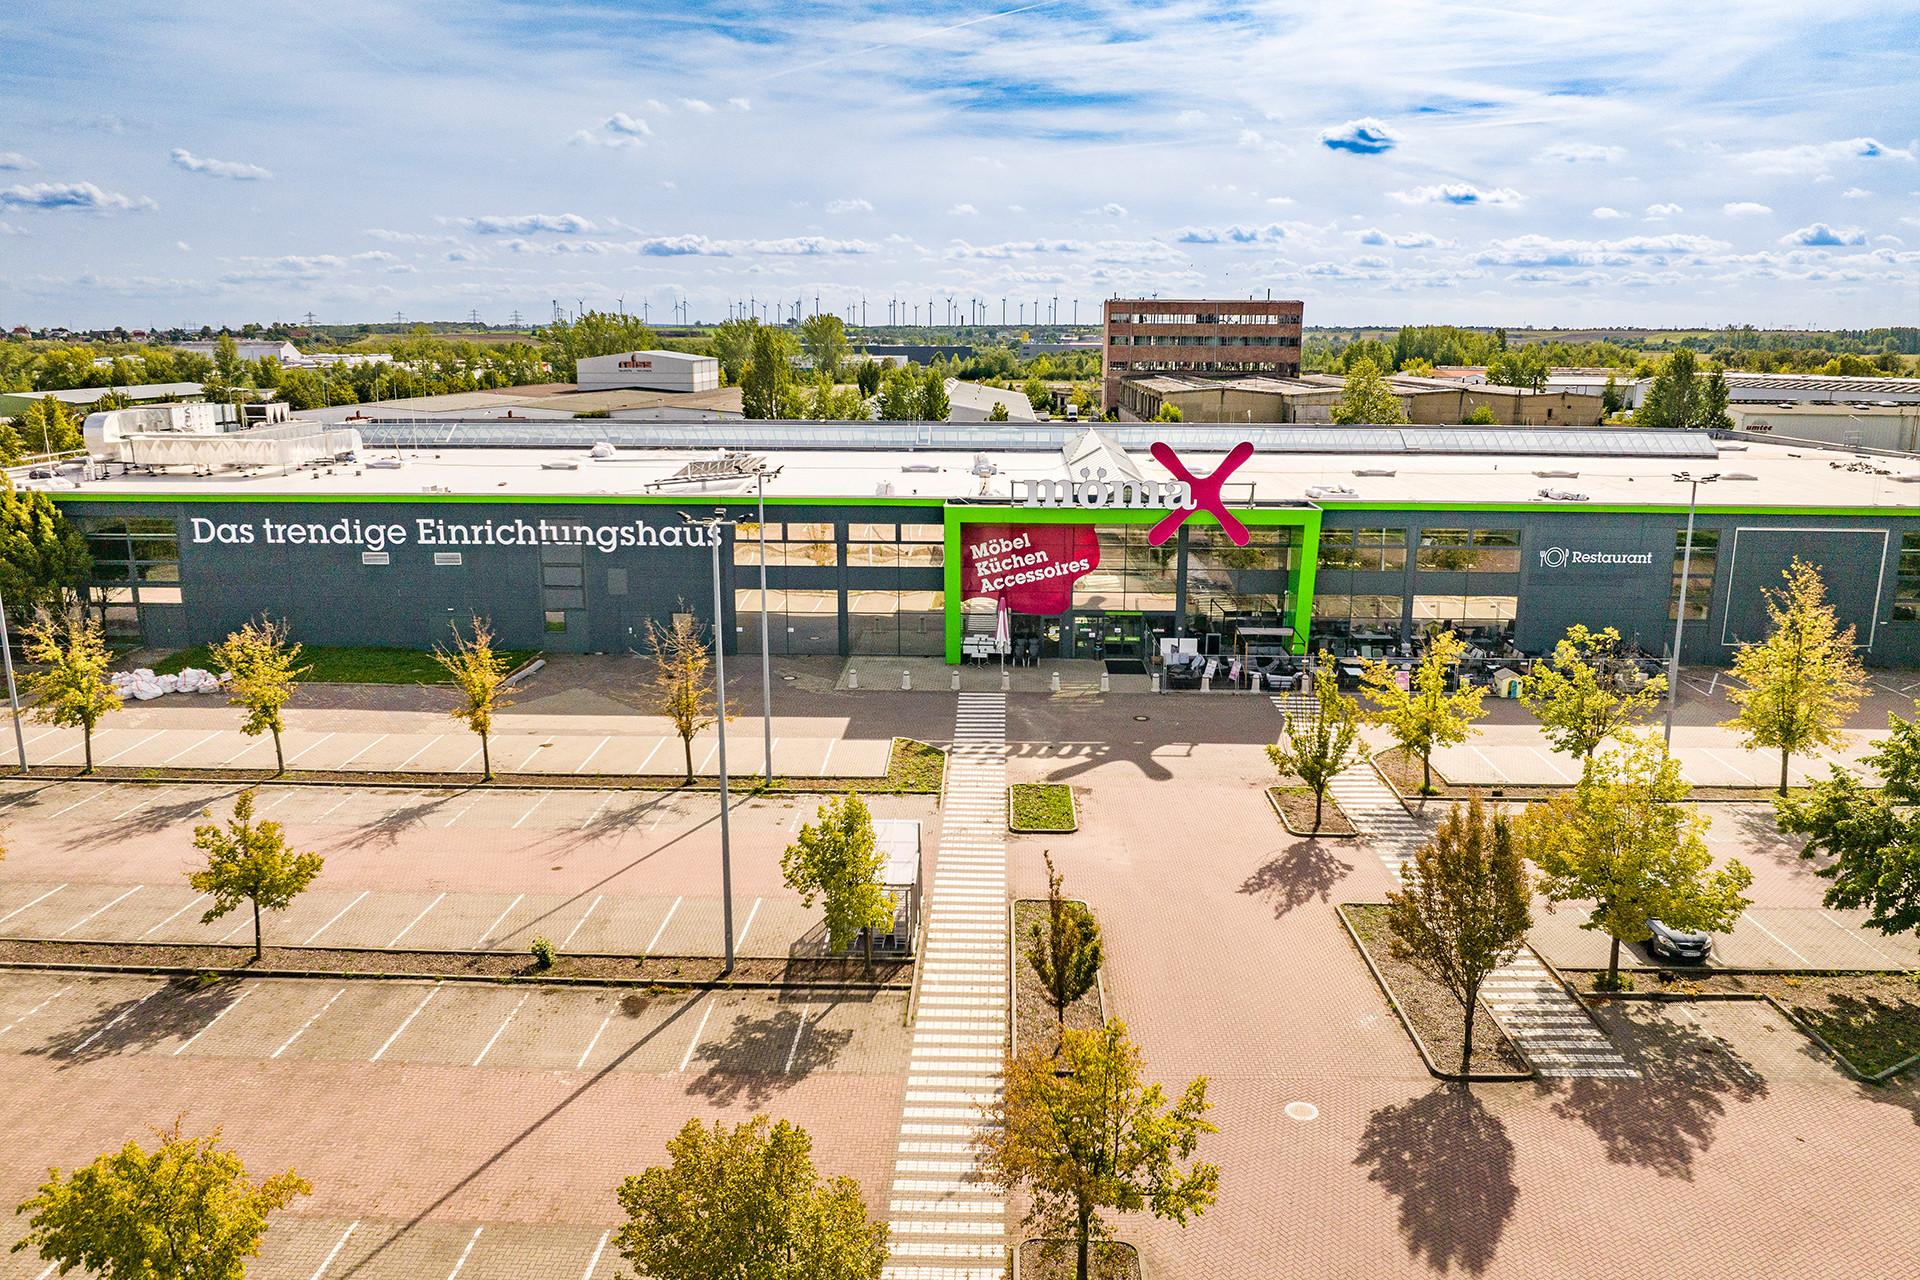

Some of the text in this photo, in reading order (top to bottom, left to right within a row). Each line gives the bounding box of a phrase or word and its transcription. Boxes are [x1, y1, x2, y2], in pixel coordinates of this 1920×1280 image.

[190, 517, 723, 553] Das trendige Einrichtungshaus
[969, 532, 1032, 560] Möbel
[974, 550, 1049, 577] Küchen
[1571, 551, 1653, 564] Restaurant
[980, 558, 1090, 594] Accessoires
